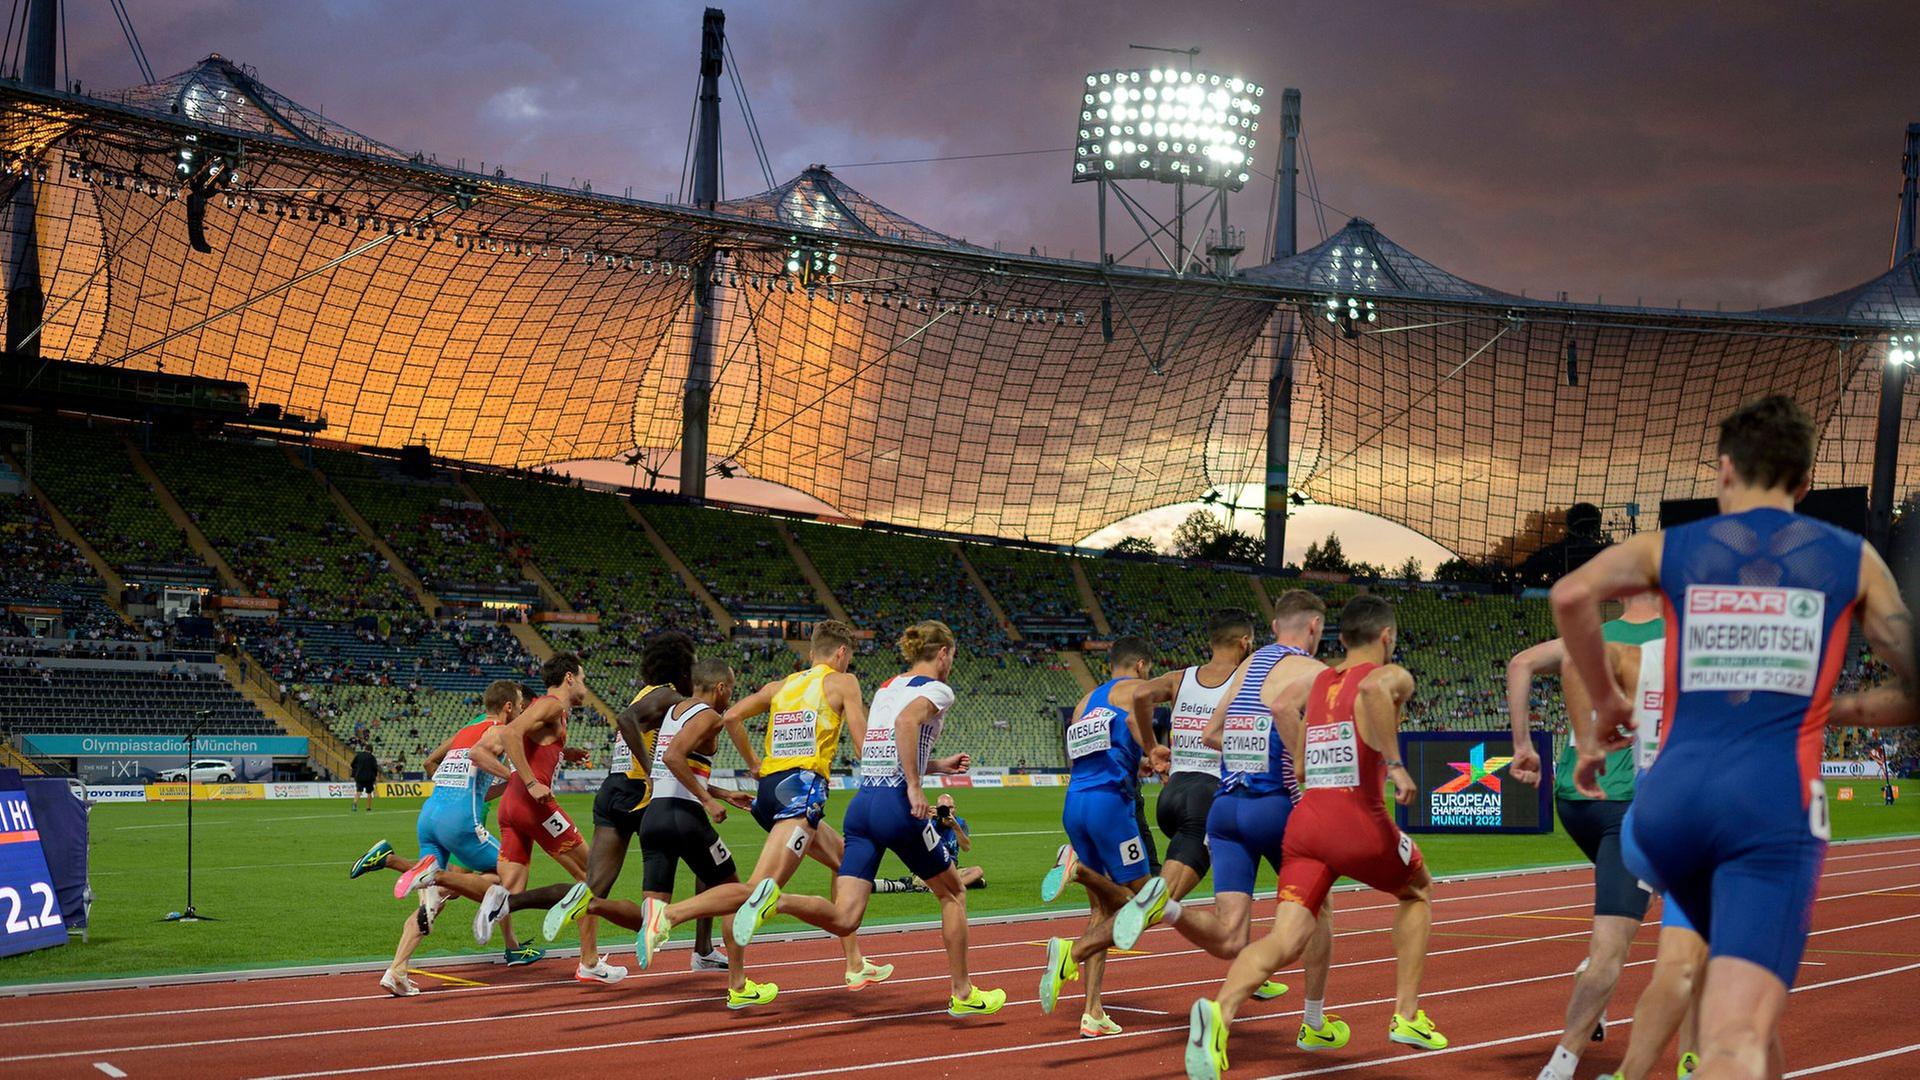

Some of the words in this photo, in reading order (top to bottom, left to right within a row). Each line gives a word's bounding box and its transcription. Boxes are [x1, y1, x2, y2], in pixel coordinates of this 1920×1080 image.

[1691, 591, 1784, 613] SPAR
[1689, 626, 1815, 653] INGEBRIGTSEN
[1690, 671, 1757, 684] MUNICH
[1763, 671, 1806, 689] 2022
[776, 712, 803, 724] SPAR
[1225, 717, 1254, 730] SPAR
[774, 725, 813, 741] PIHLSTRÖM
[866, 730, 889, 741] SPAR
[1069, 720, 1107, 740] MESLEK
[1308, 726, 1338, 743] SPAR
[82, 738, 189, 752] Olympiastadion
[195, 737, 257, 751] München
[1224, 736, 1266, 751] HEYWARD
[863, 746, 896, 758] MISCHLER
[1307, 746, 1353, 765] FONTES
[111, 760, 139, 778] iX1
[386, 783, 423, 797] ADAC
[1431, 794, 1501, 806] EUROPEAN
[8, 799, 34, 830] H1
[1431, 806, 1501, 816] CHAMPIONSHIPS
[550, 818, 563, 832] 3
[1431, 816, 1472, 826] MUNICH
[1475, 816, 1502, 826] 2022
[926, 826, 936, 844] 7
[794, 835, 805, 851] 6
[718, 844, 727, 859] 5
[1128, 843, 1140, 860] 8
